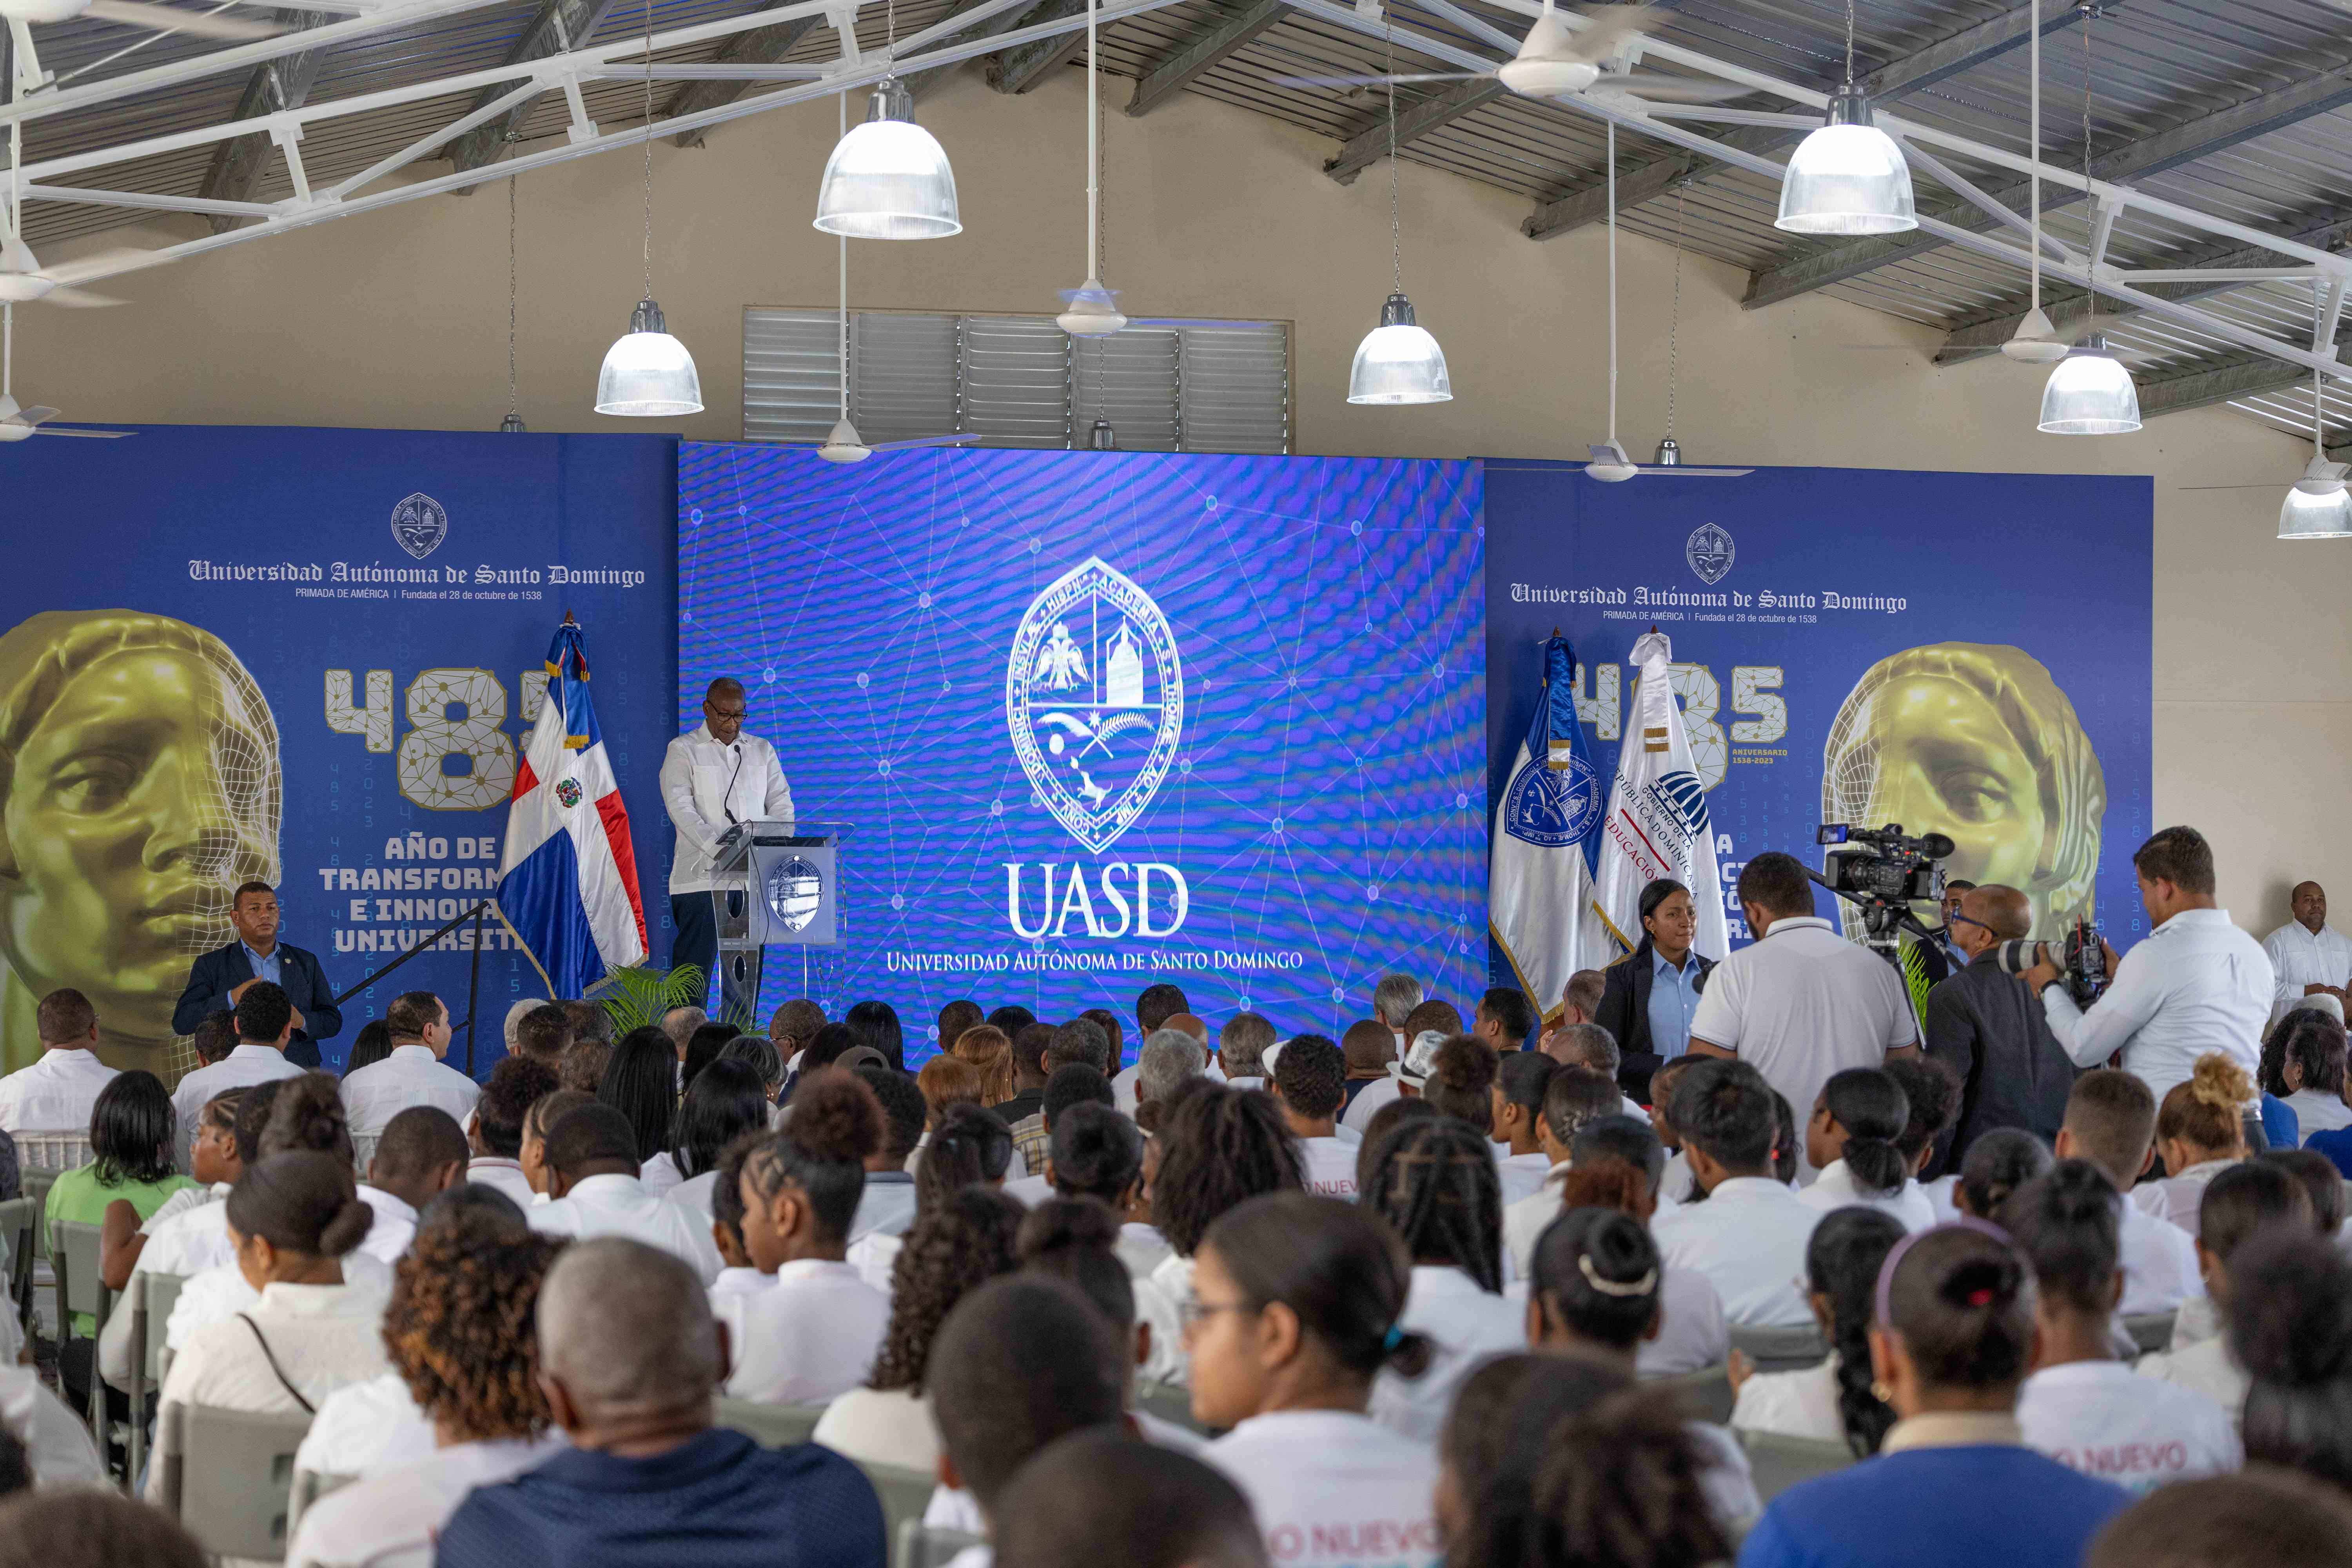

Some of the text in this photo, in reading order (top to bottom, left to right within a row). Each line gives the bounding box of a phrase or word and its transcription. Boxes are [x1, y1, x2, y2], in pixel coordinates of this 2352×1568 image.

[188, 560, 645, 588] Universidad Autónoma de Santo Domingo
[296, 588, 542, 600] PRIMADA DE AMÉRICA Fundada el 28 de octubre de 1538
[1100, 575, 1158, 634] ACADEMIA
[1511, 583, 1906, 613] Universidad Autónoma de Santo Domingo
[1603, 610, 1817, 623] PRIMADA DE AMÉRICA Fundada el 28 de octubre de 1538
[1516, 766, 1536, 791] DOMINICI
[1642, 787, 1691, 851] GOBIERNO DE LA
[385, 831, 496, 860] AÑO DE
[1615, 767, 1697, 900] EPÚBLICA DOMINICANA
[319, 868, 500, 890] TRANSFORM
[350, 898, 499, 921] E INNOVA
[1002, 860, 1189, 938] UASD
[335, 928, 521, 952] UNIVERSIT
[1314, 1179, 1359, 1194] NUEV
